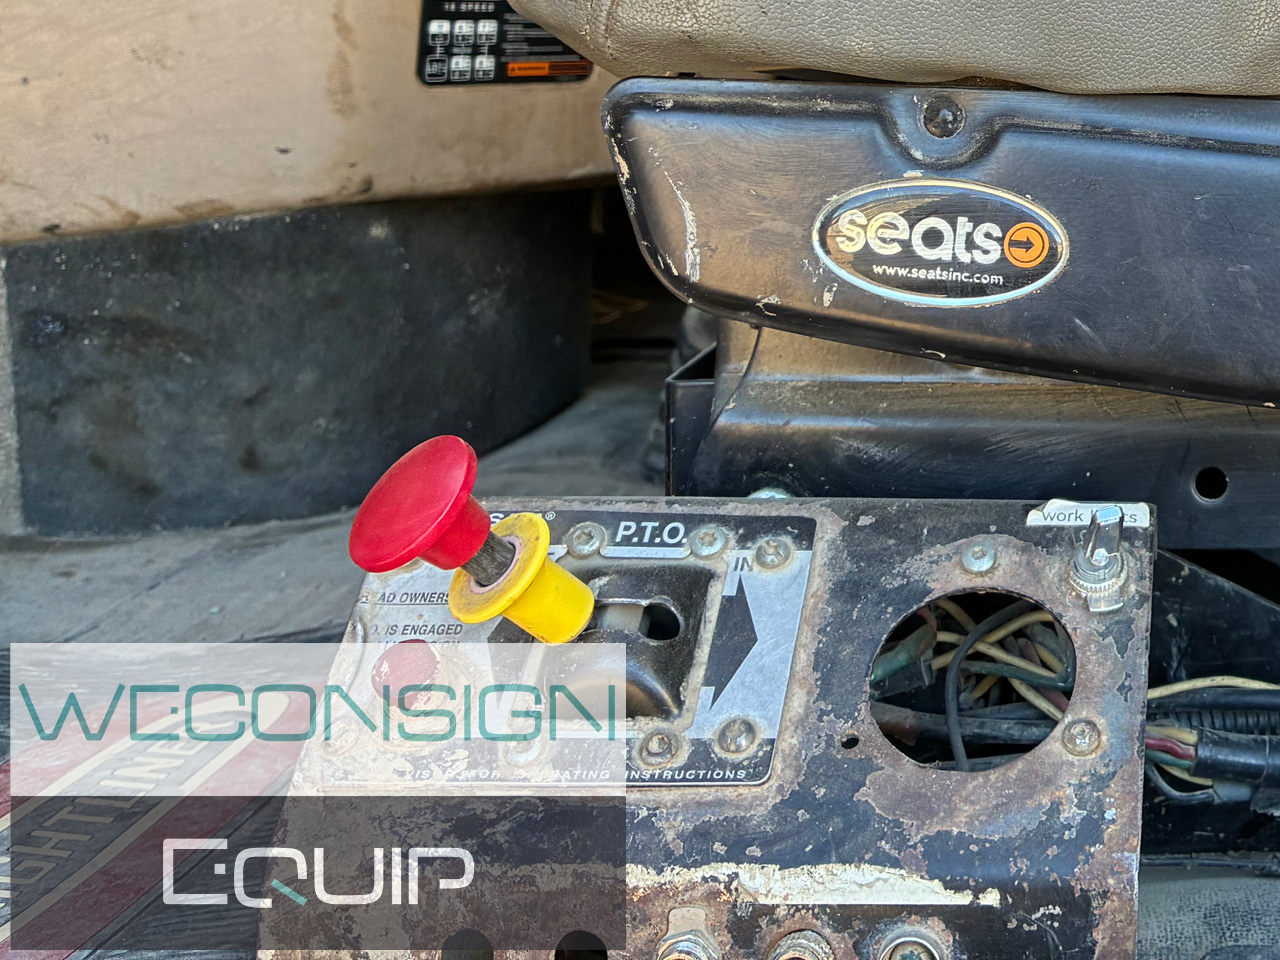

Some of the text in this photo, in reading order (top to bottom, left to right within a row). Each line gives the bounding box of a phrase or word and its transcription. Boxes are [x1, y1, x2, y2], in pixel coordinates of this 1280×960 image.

[460, 2, 495, 12] SPEED
[836, 209, 1003, 265] seats
[872, 263, 1004, 286] www.seatsinc.com
[1042, 509, 1084, 523] work
[615, 521, 688, 544] P.T.O.
[733, 556, 754, 572] IN
[401, 623, 463, 636] ENGAGED
[624, 770, 748, 780] INSTRUCTIONS
